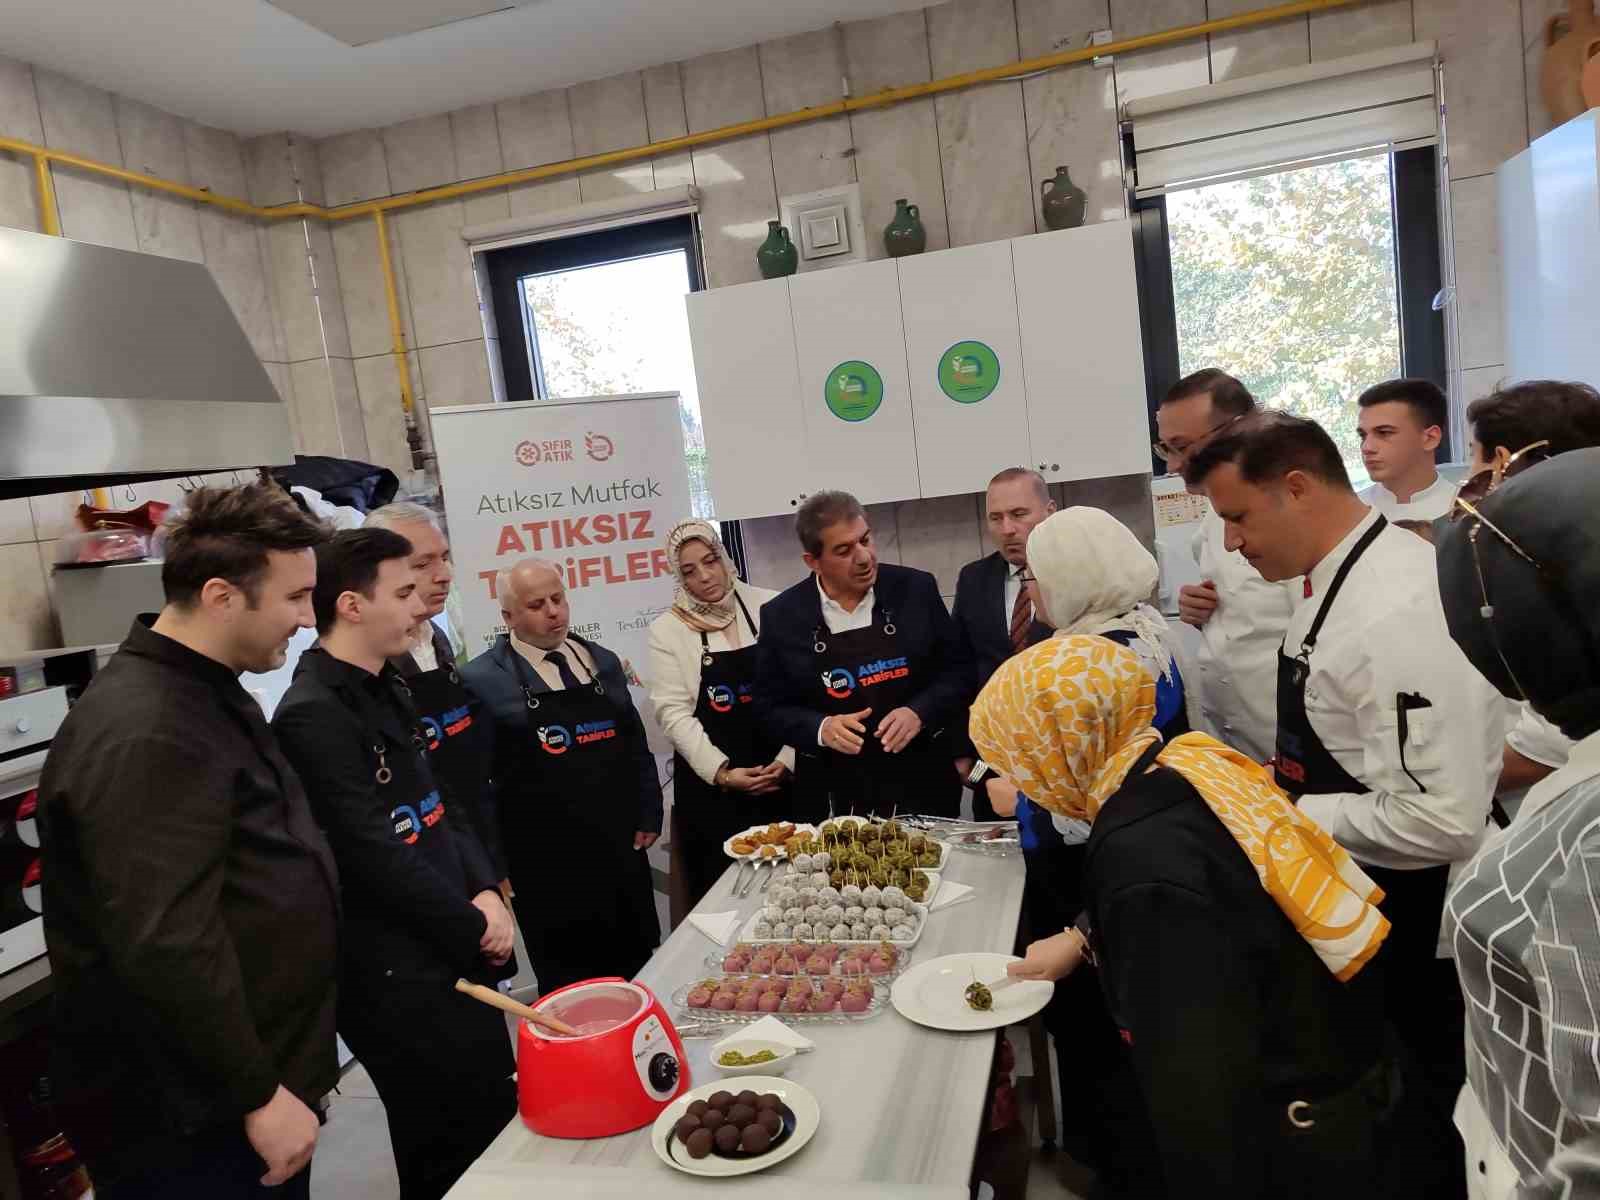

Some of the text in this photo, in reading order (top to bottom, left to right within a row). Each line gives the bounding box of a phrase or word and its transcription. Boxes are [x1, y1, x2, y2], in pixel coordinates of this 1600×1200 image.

[542, 439, 573, 452] SIFIR
[544, 451, 574, 463] ATIK
[476, 477, 662, 515] Atıksız Mutfak
[495, 510, 655, 556] ATIKSIZ
[479, 549, 672, 600] TİFLER
